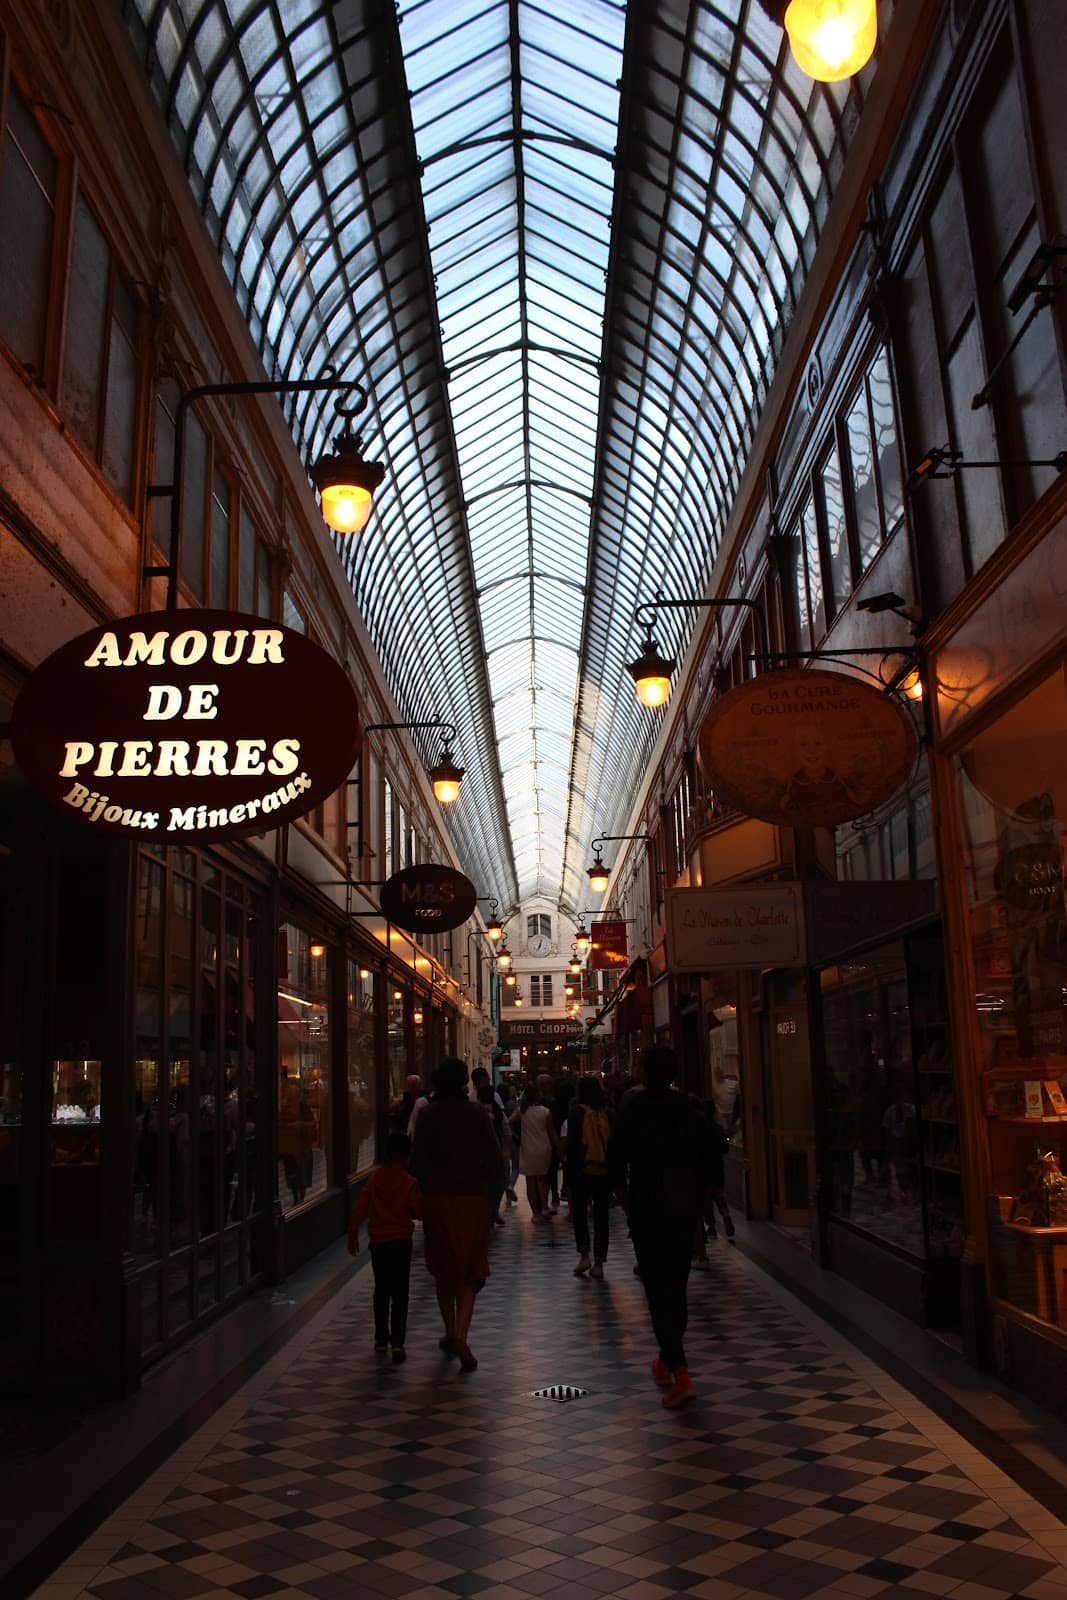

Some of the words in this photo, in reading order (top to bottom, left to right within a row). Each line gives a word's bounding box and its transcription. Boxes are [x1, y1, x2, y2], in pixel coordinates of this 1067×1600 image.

[84, 629, 286, 667] AMOUR
[142, 684, 220, 721] DE
[58, 738, 302, 778] PIERRES
[62, 781, 160, 831] Bijoux
[166, 771, 313, 831] Mineraux
